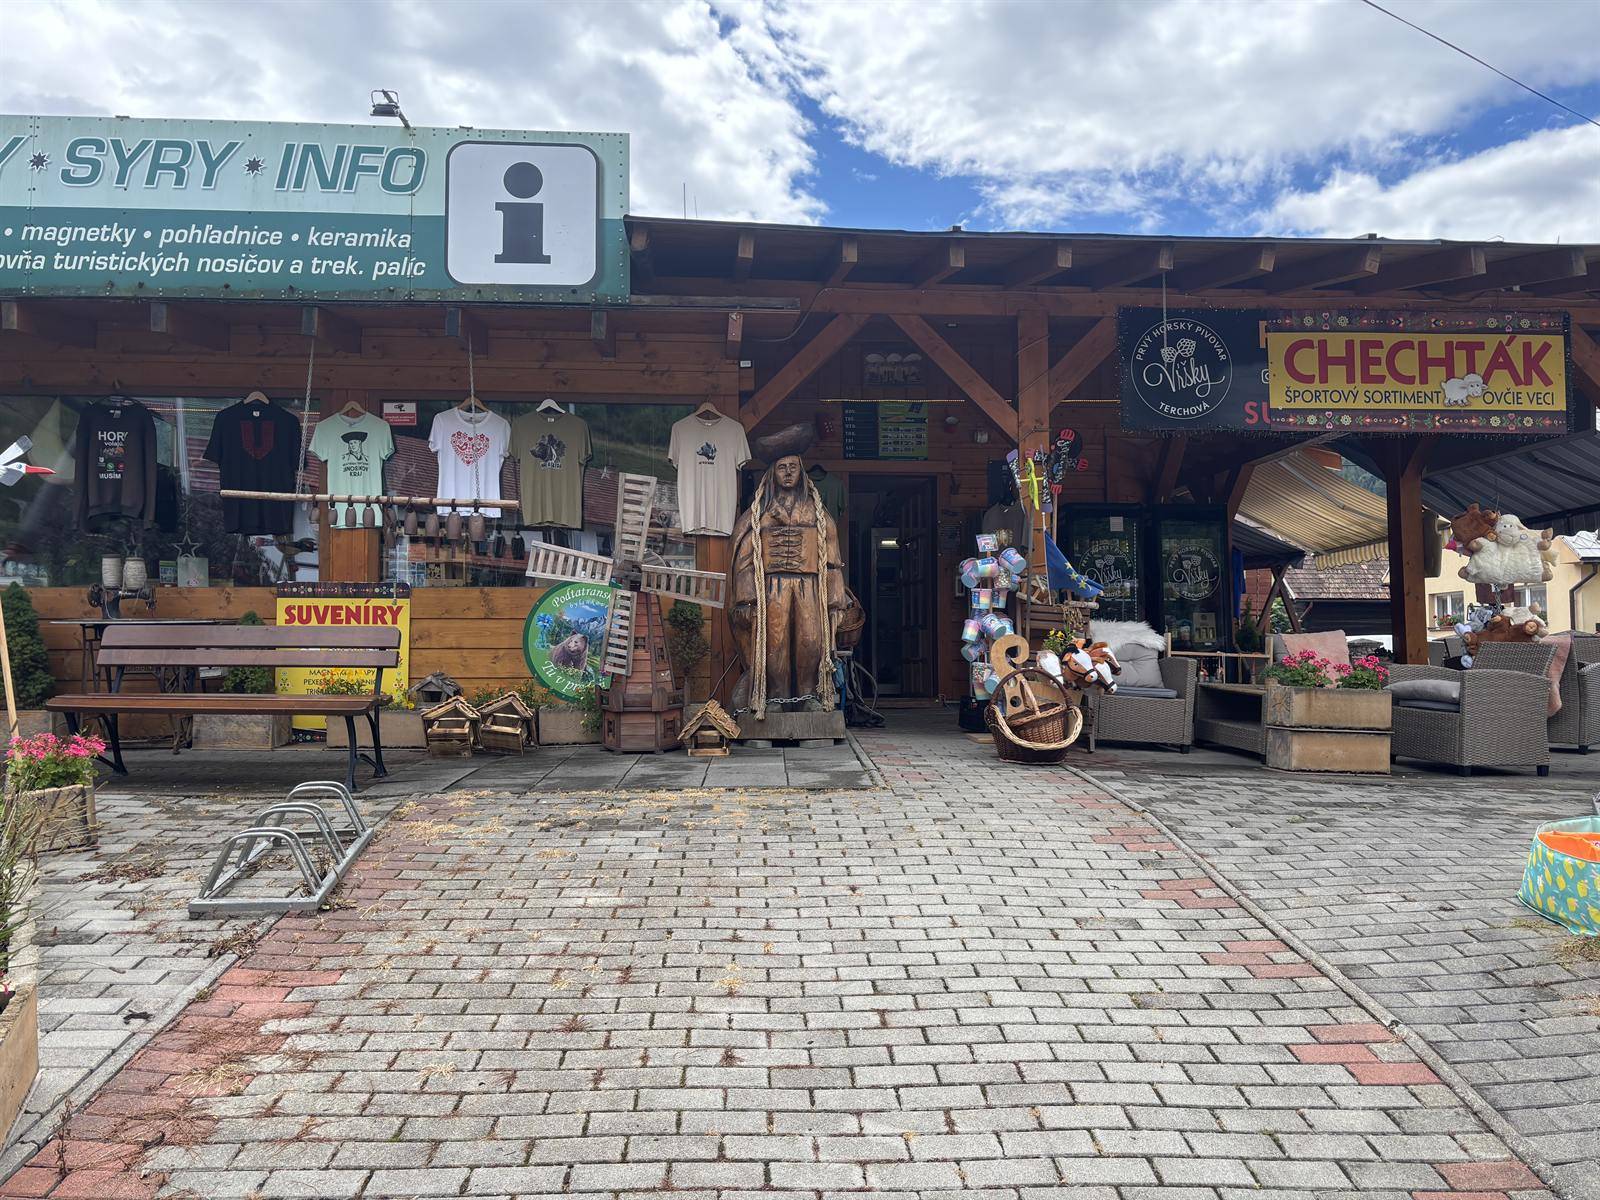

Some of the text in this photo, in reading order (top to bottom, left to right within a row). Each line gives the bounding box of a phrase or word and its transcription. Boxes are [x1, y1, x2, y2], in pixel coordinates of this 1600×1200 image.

[59, 136, 244, 190] SYRY
[274, 141, 428, 195] INFO
[21, 222, 412, 249] magnetky pohľadnice keramika
[0, 249, 426, 280] vňa turistických nosičov a trek. palíc
[1195, 326, 1227, 361] PIVOVAR
[1283, 335, 1554, 388] CHECHTÁK
[1285, 386, 1555, 406] ŠPORTOVÝ SORTIMENT OVČIE VECI
[284, 599, 404, 625] SUVENÍRY
[541, 660, 556, 678] Tu
